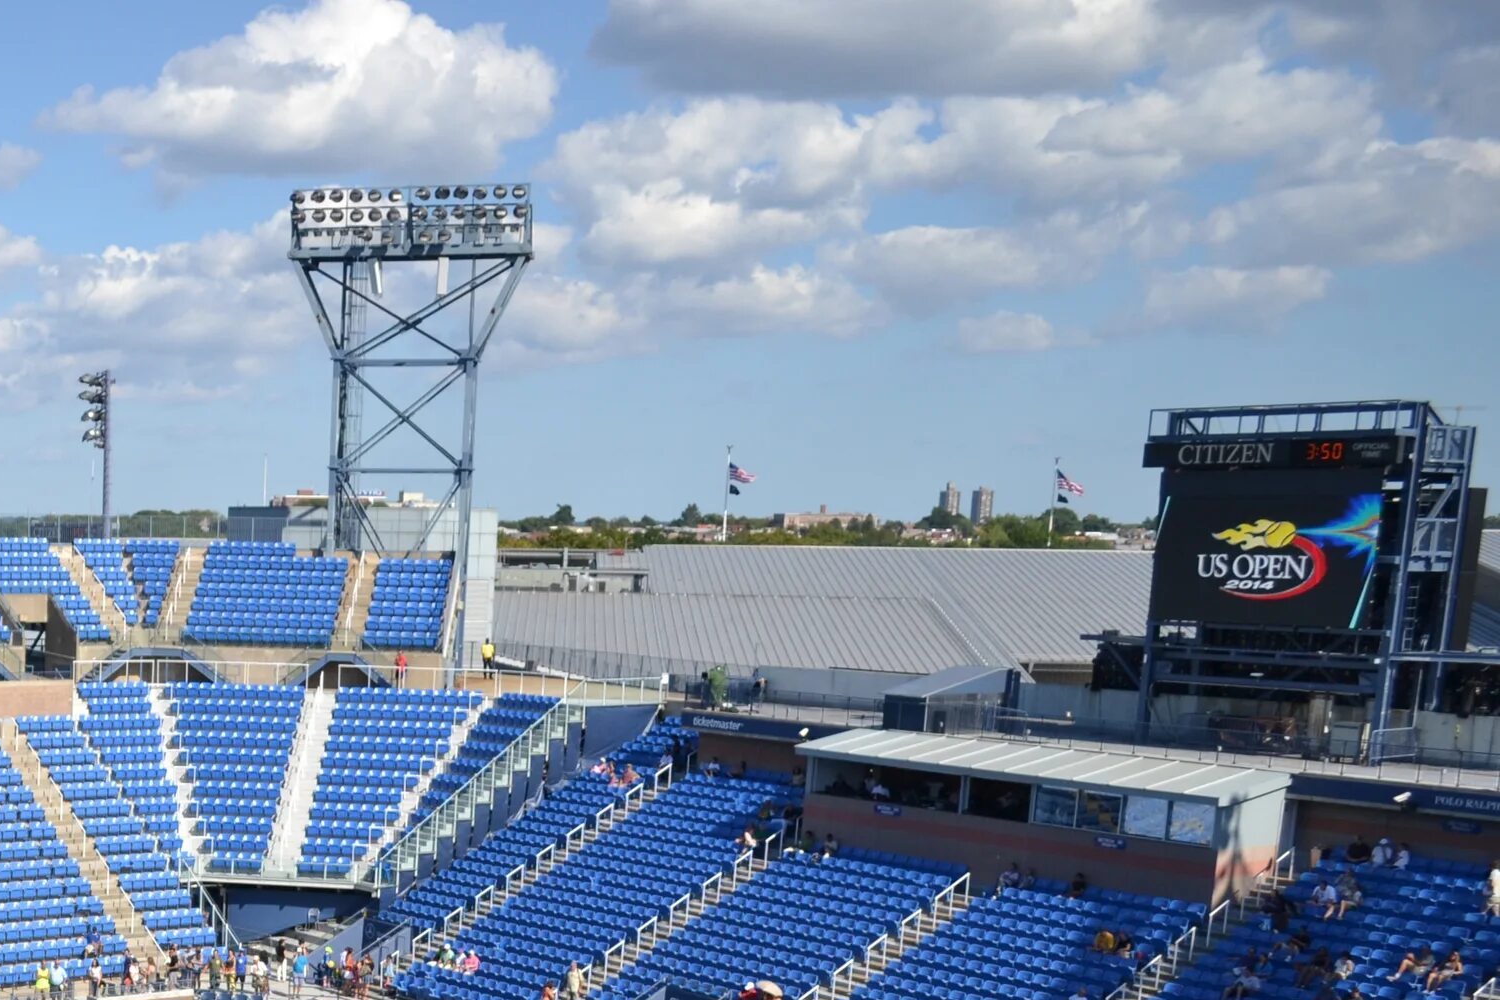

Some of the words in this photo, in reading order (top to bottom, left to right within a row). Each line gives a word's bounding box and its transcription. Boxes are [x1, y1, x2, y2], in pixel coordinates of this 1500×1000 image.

[1177, 443, 1274, 464] CITIZEN
[1305, 442, 1343, 460] 3:50
[1197, 554, 1228, 578] US
[1232, 554, 1308, 580] OPEN
[1224, 580, 1274, 590] 2014
[693, 716, 741, 731] ticketmaster
[1434, 796, 1464, 807] POLO
